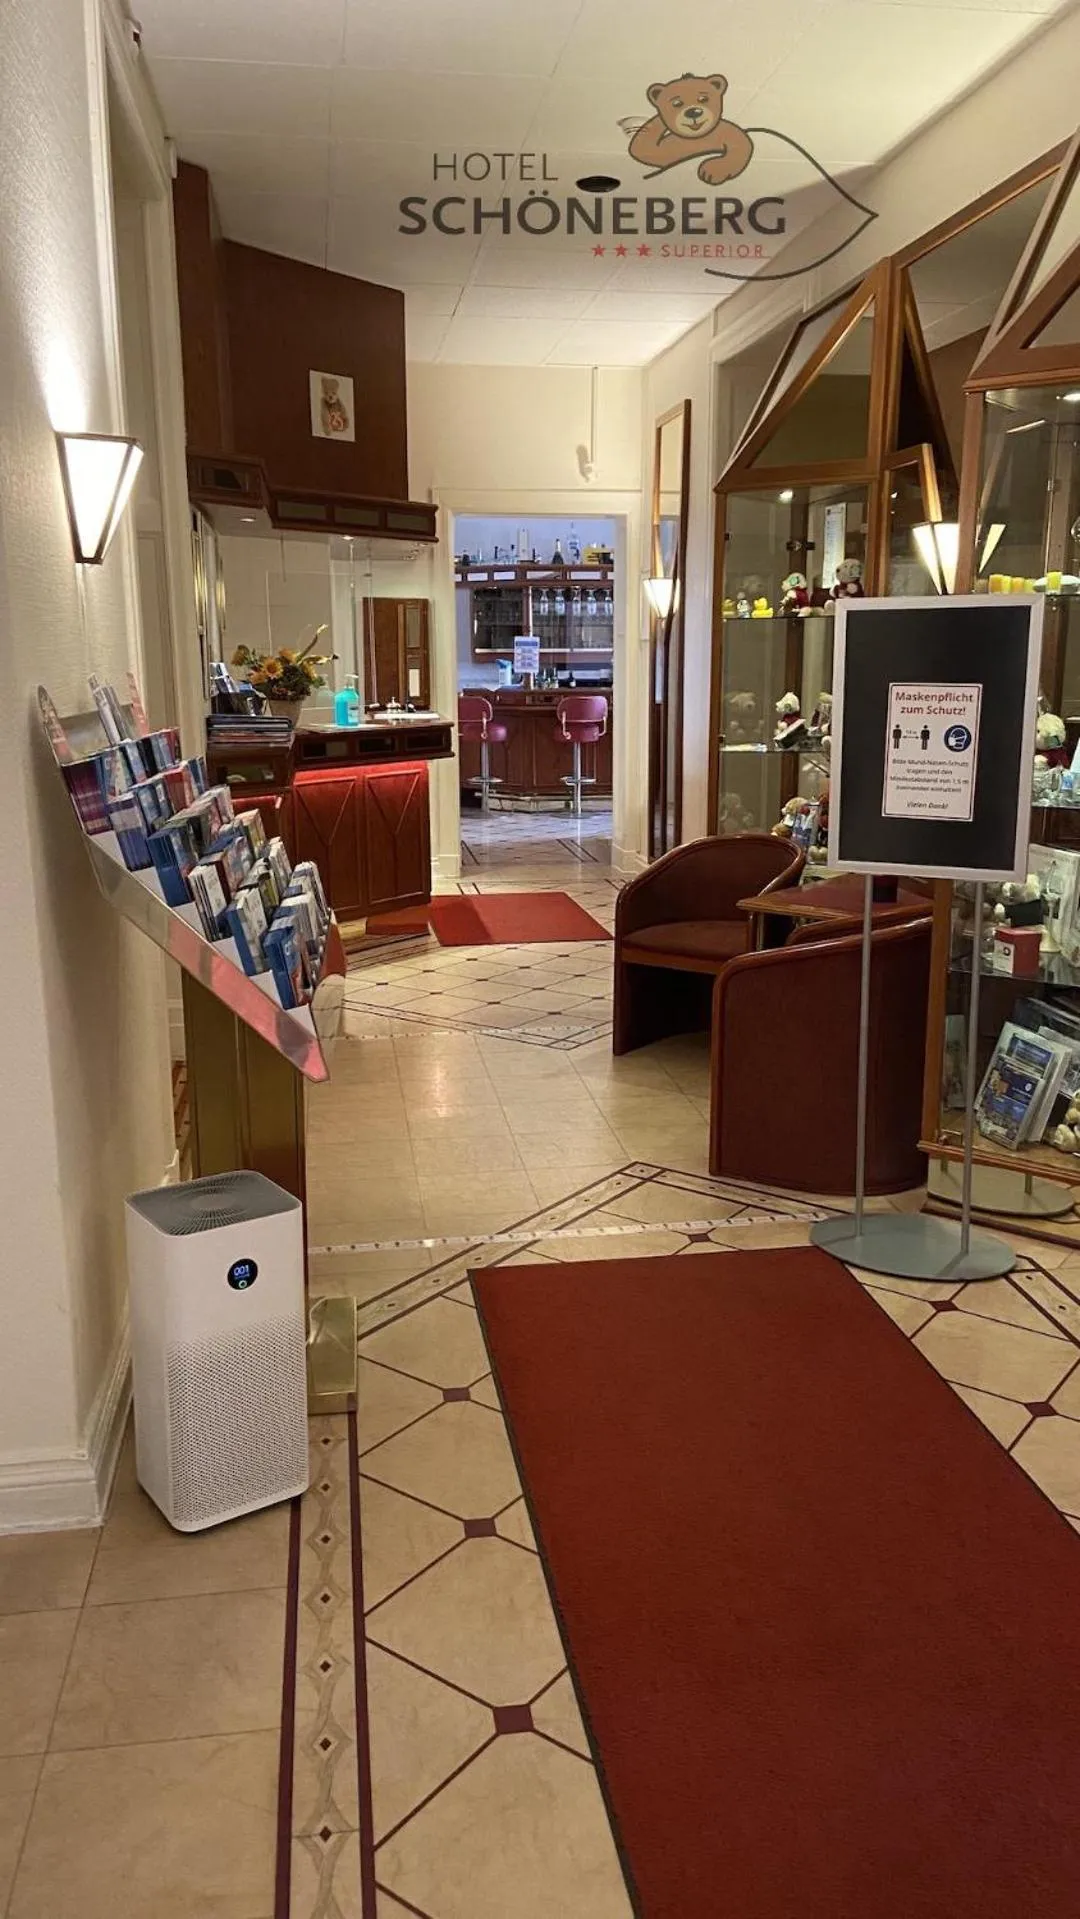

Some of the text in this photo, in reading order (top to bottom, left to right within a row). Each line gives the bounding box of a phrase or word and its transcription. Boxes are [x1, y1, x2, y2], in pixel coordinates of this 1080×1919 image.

[895, 692, 974, 703] Maskenpflicht
[900, 706, 966, 716] zum Schutz!
[928, 802, 949, 810] Dank!
[233, 1264, 249, 1276] 001
